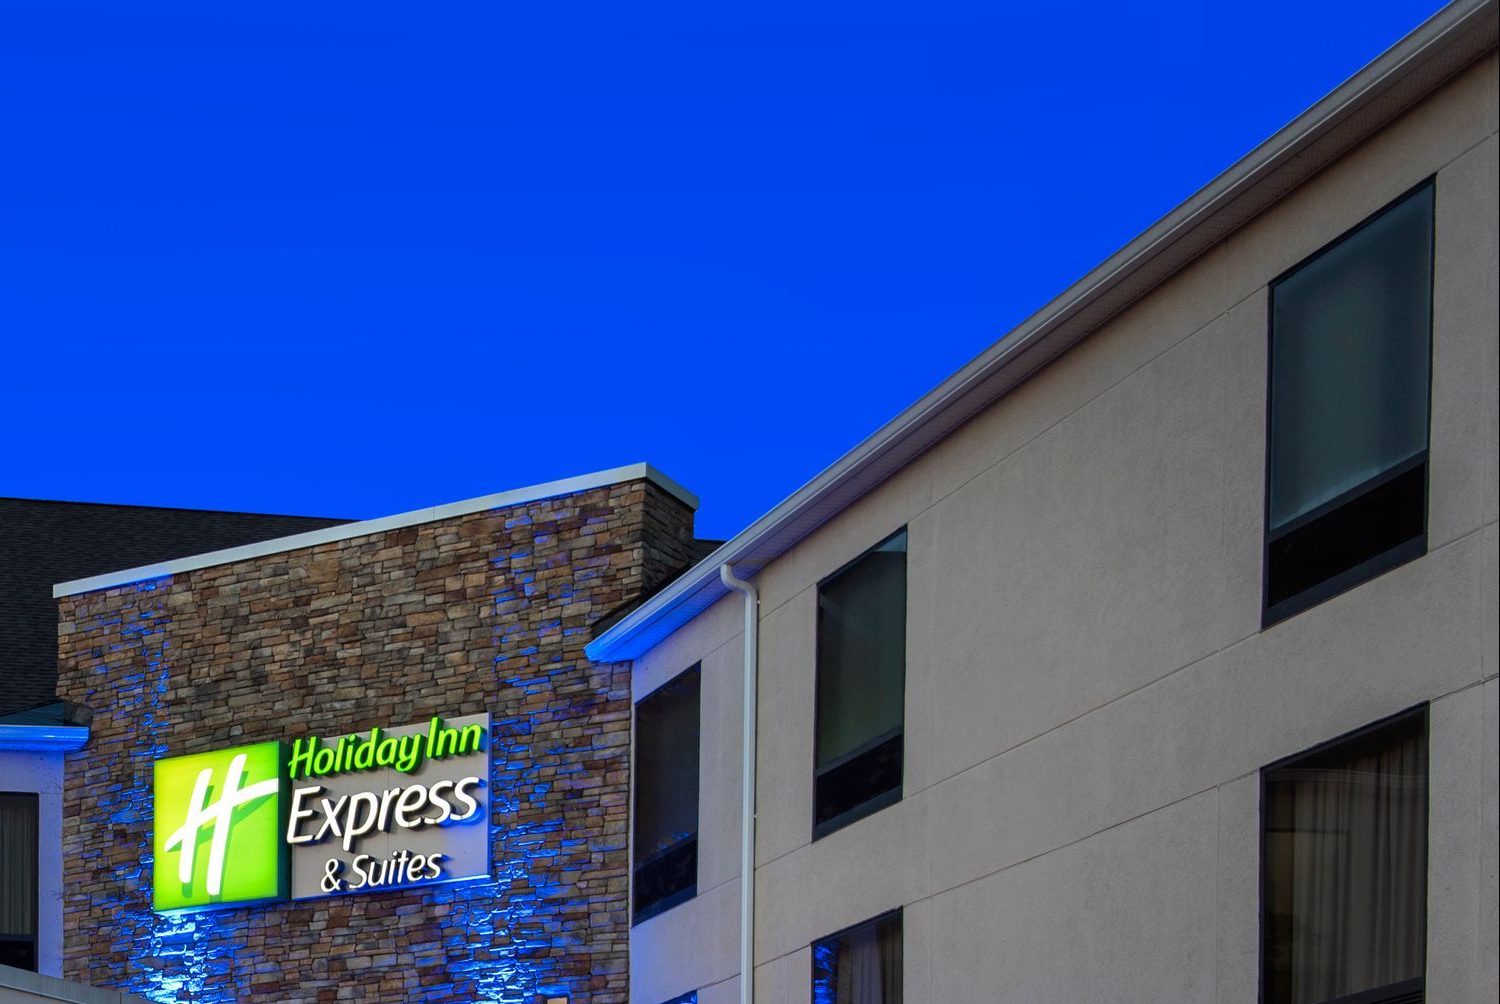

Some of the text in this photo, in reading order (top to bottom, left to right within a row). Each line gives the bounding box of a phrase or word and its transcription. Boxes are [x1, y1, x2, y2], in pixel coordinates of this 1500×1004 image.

[288, 716, 486, 779] Holiday Inn
[286, 776, 479, 851] Express
[320, 850, 443, 893] & Suites
